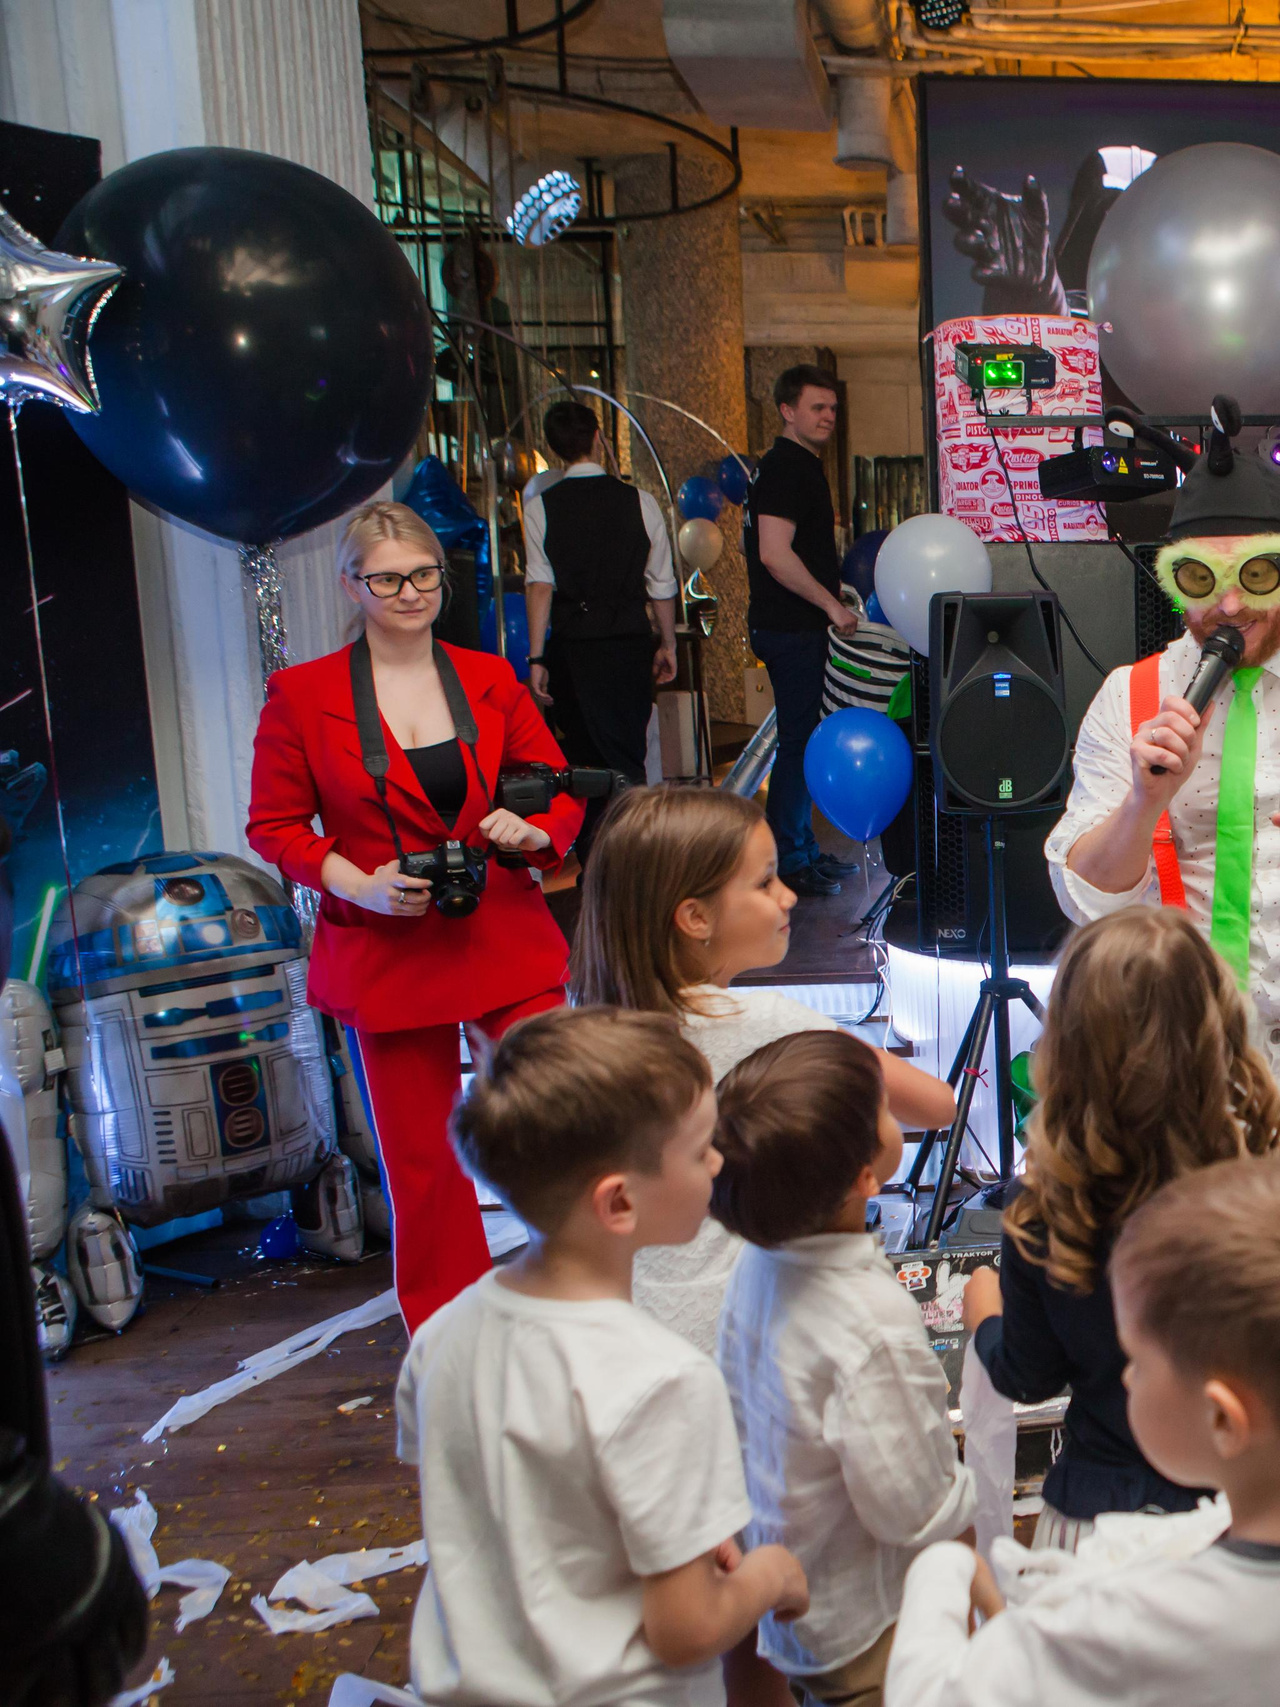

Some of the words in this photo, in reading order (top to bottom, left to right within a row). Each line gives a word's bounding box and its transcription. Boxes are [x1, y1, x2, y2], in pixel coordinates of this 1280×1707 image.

[967, 424, 993, 435] PISTO
[956, 482, 979, 491] DIATOR
[1010, 481, 1039, 490] SPRING
[999, 779, 1012, 792] dB
[938, 928, 966, 939] NEXO
[951, 1250, 993, 1258] TRAKTOR
[928, 1338, 959, 1347] oPro
